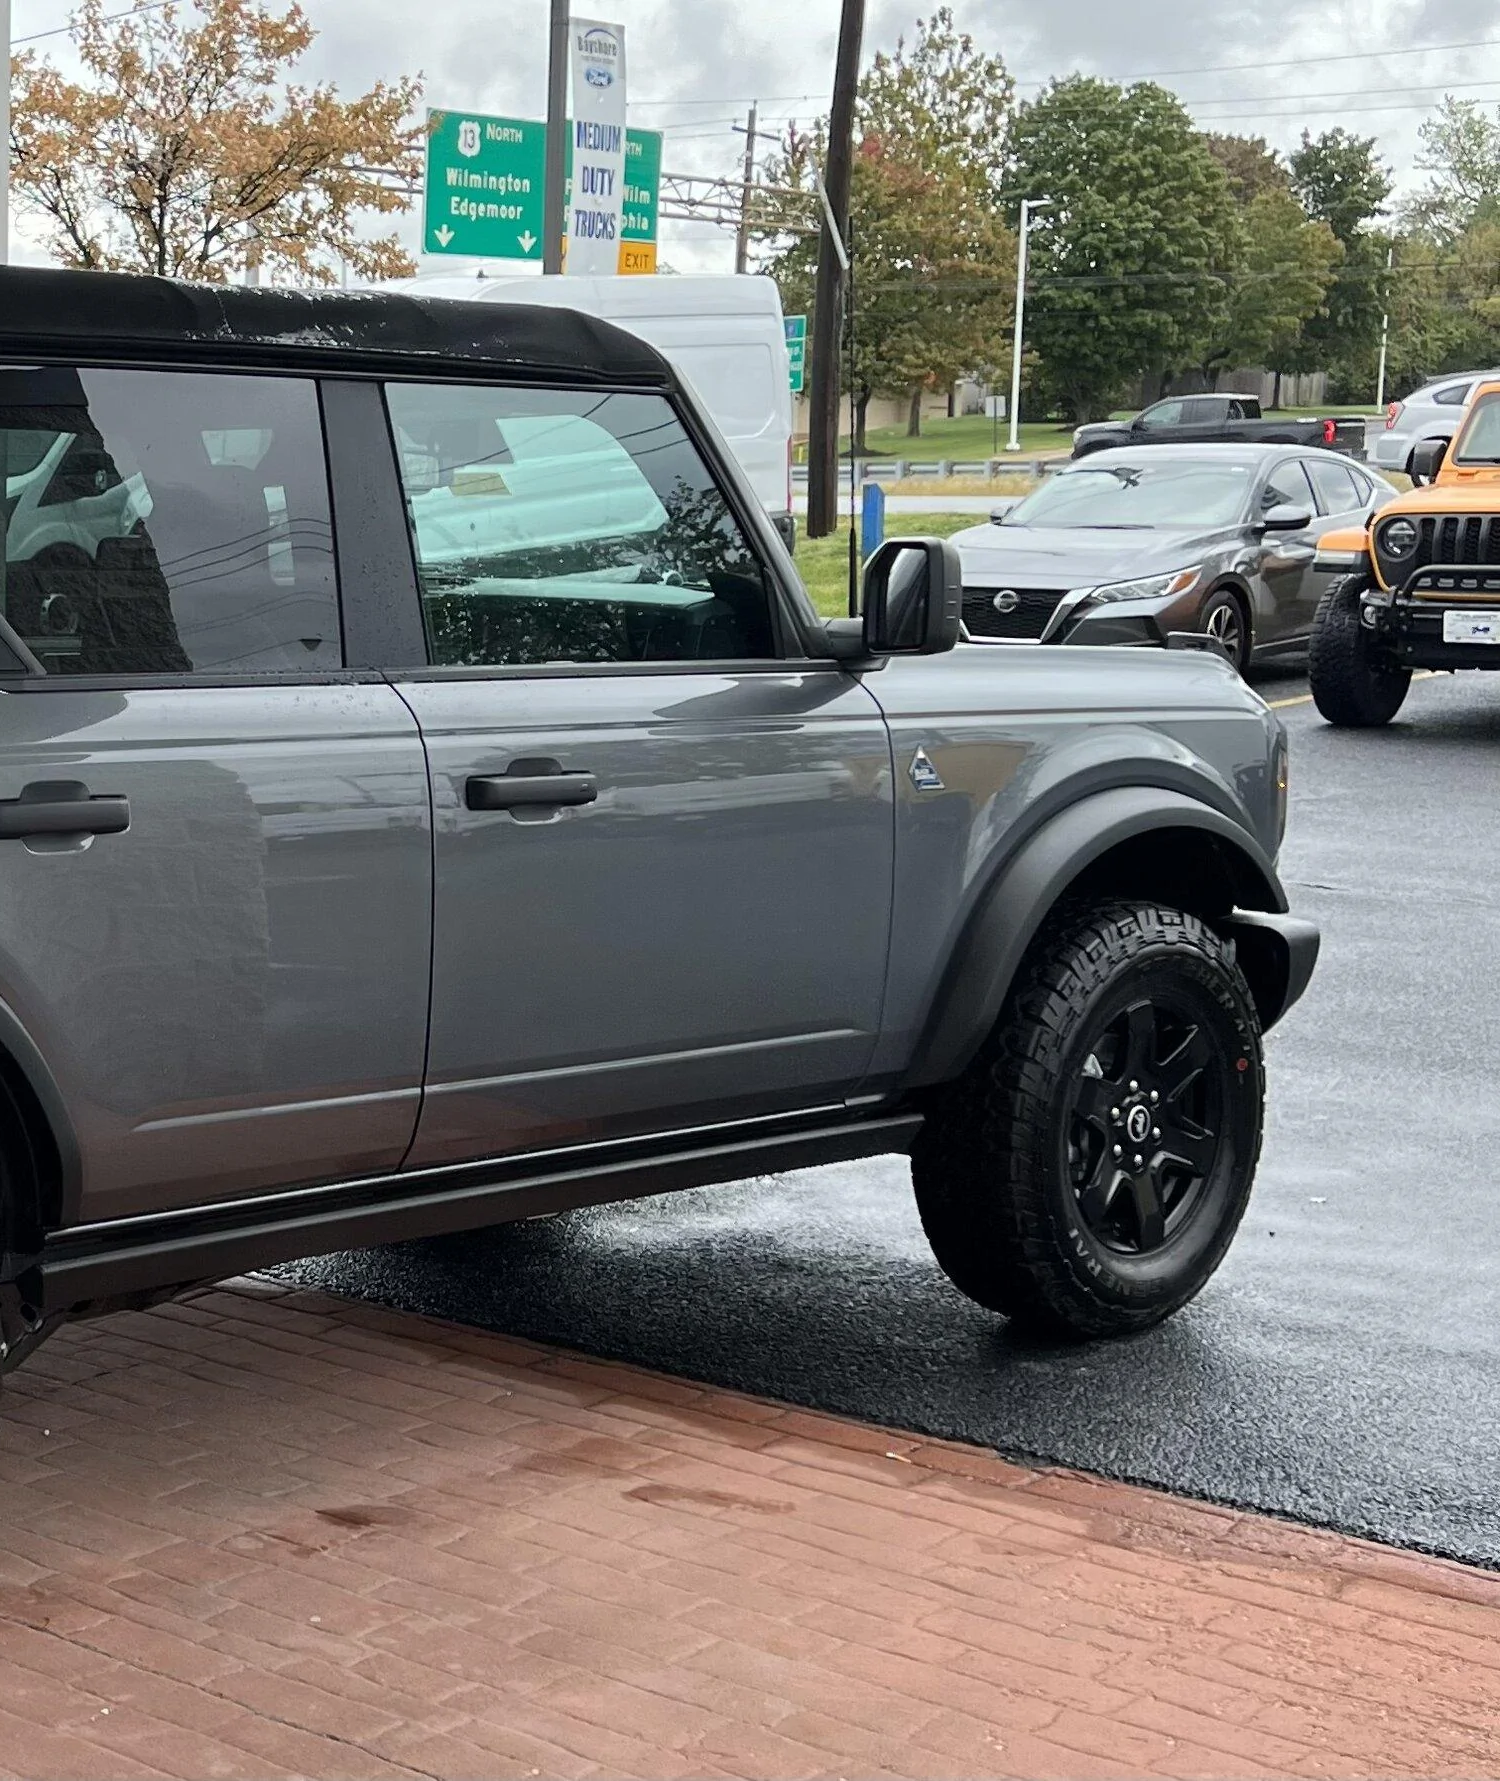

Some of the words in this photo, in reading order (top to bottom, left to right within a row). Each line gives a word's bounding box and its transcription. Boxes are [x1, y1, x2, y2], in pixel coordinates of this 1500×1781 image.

[463, 129, 475, 149] 13
[486, 122, 523, 143] NORTH
[576, 121, 621, 153] MEDIUM
[446, 167, 530, 195] Wilmington
[582, 165, 615, 196] DUTY
[451, 196, 523, 221] Edgemoor
[575, 208, 616, 240] TRUCKS
[625, 253, 649, 269] EXIT
